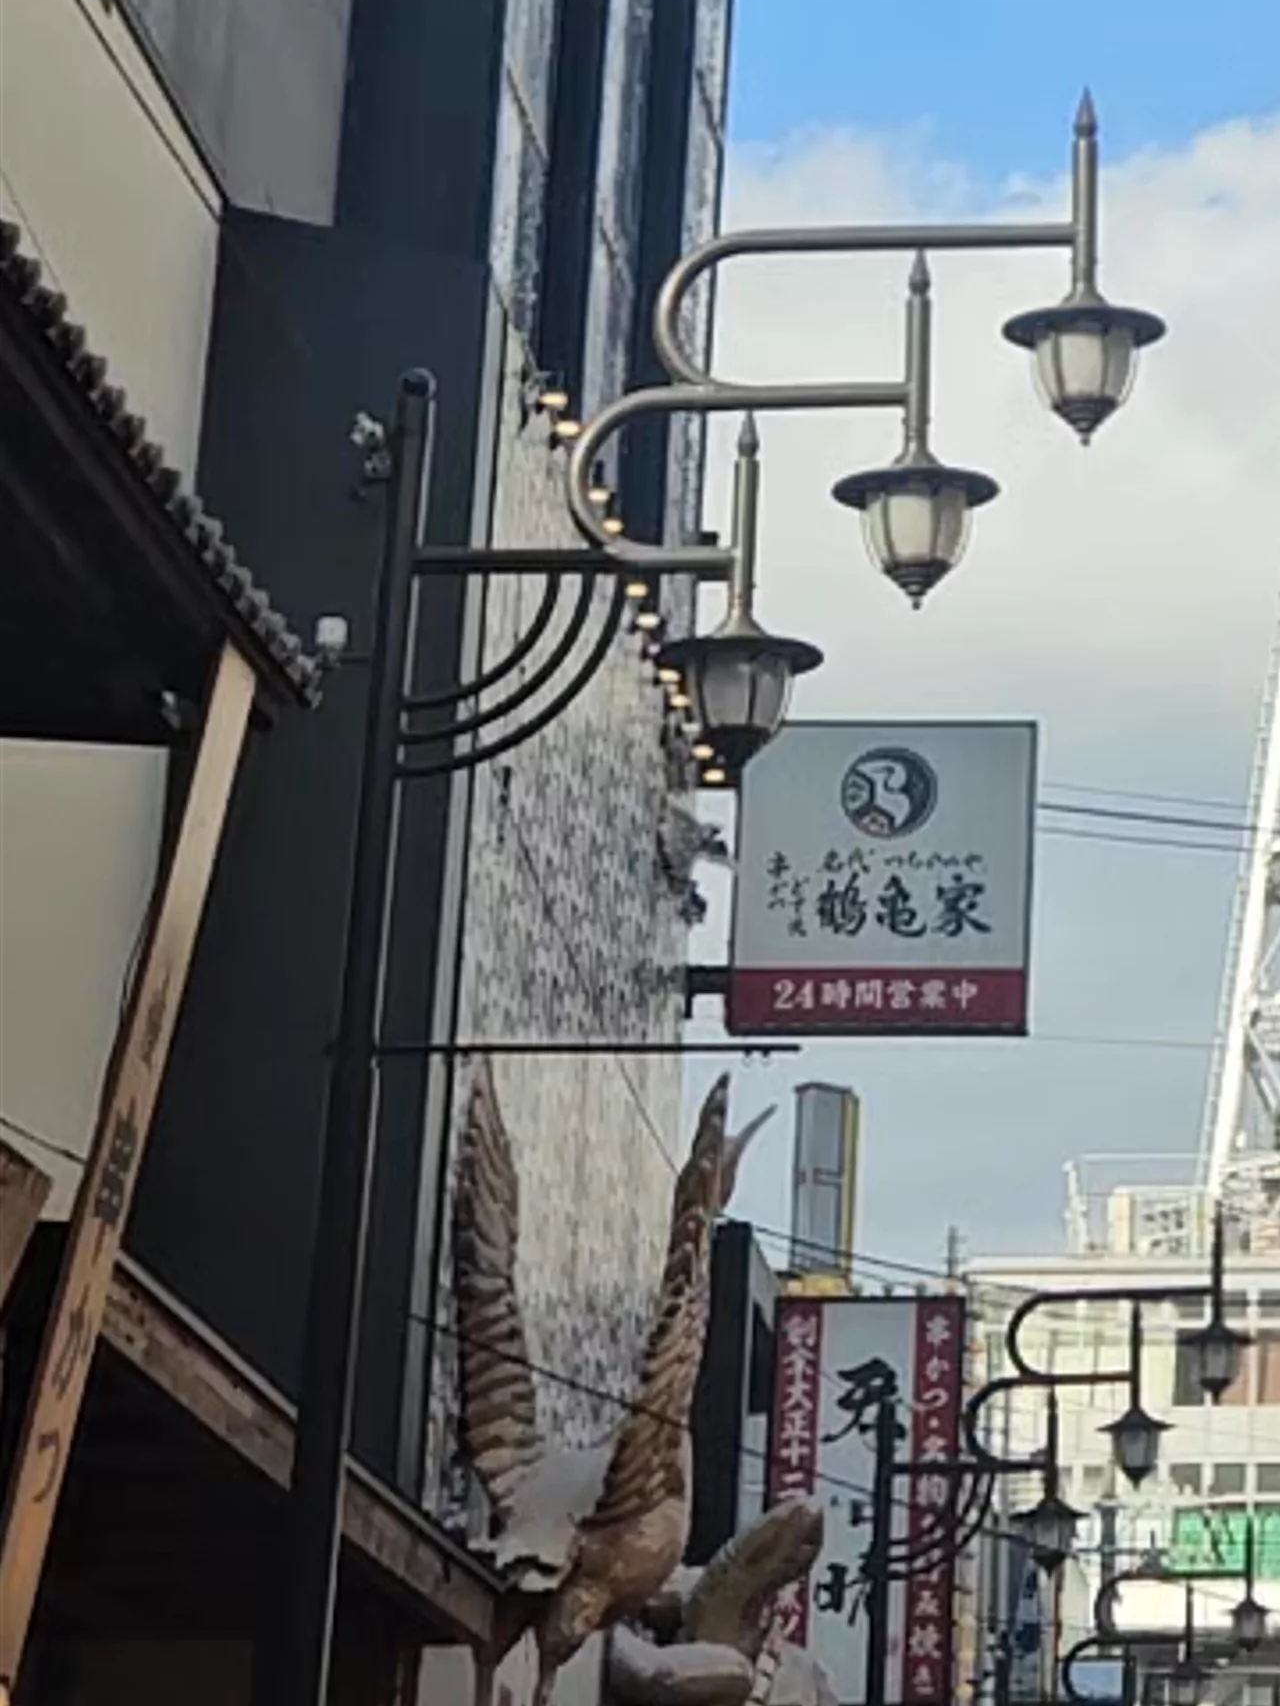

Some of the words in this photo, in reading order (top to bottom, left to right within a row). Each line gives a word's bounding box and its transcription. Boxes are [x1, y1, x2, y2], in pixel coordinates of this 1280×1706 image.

[816, 872, 994, 938] 鶴亀家
[773, 978, 980, 1012] 24時間営業中
